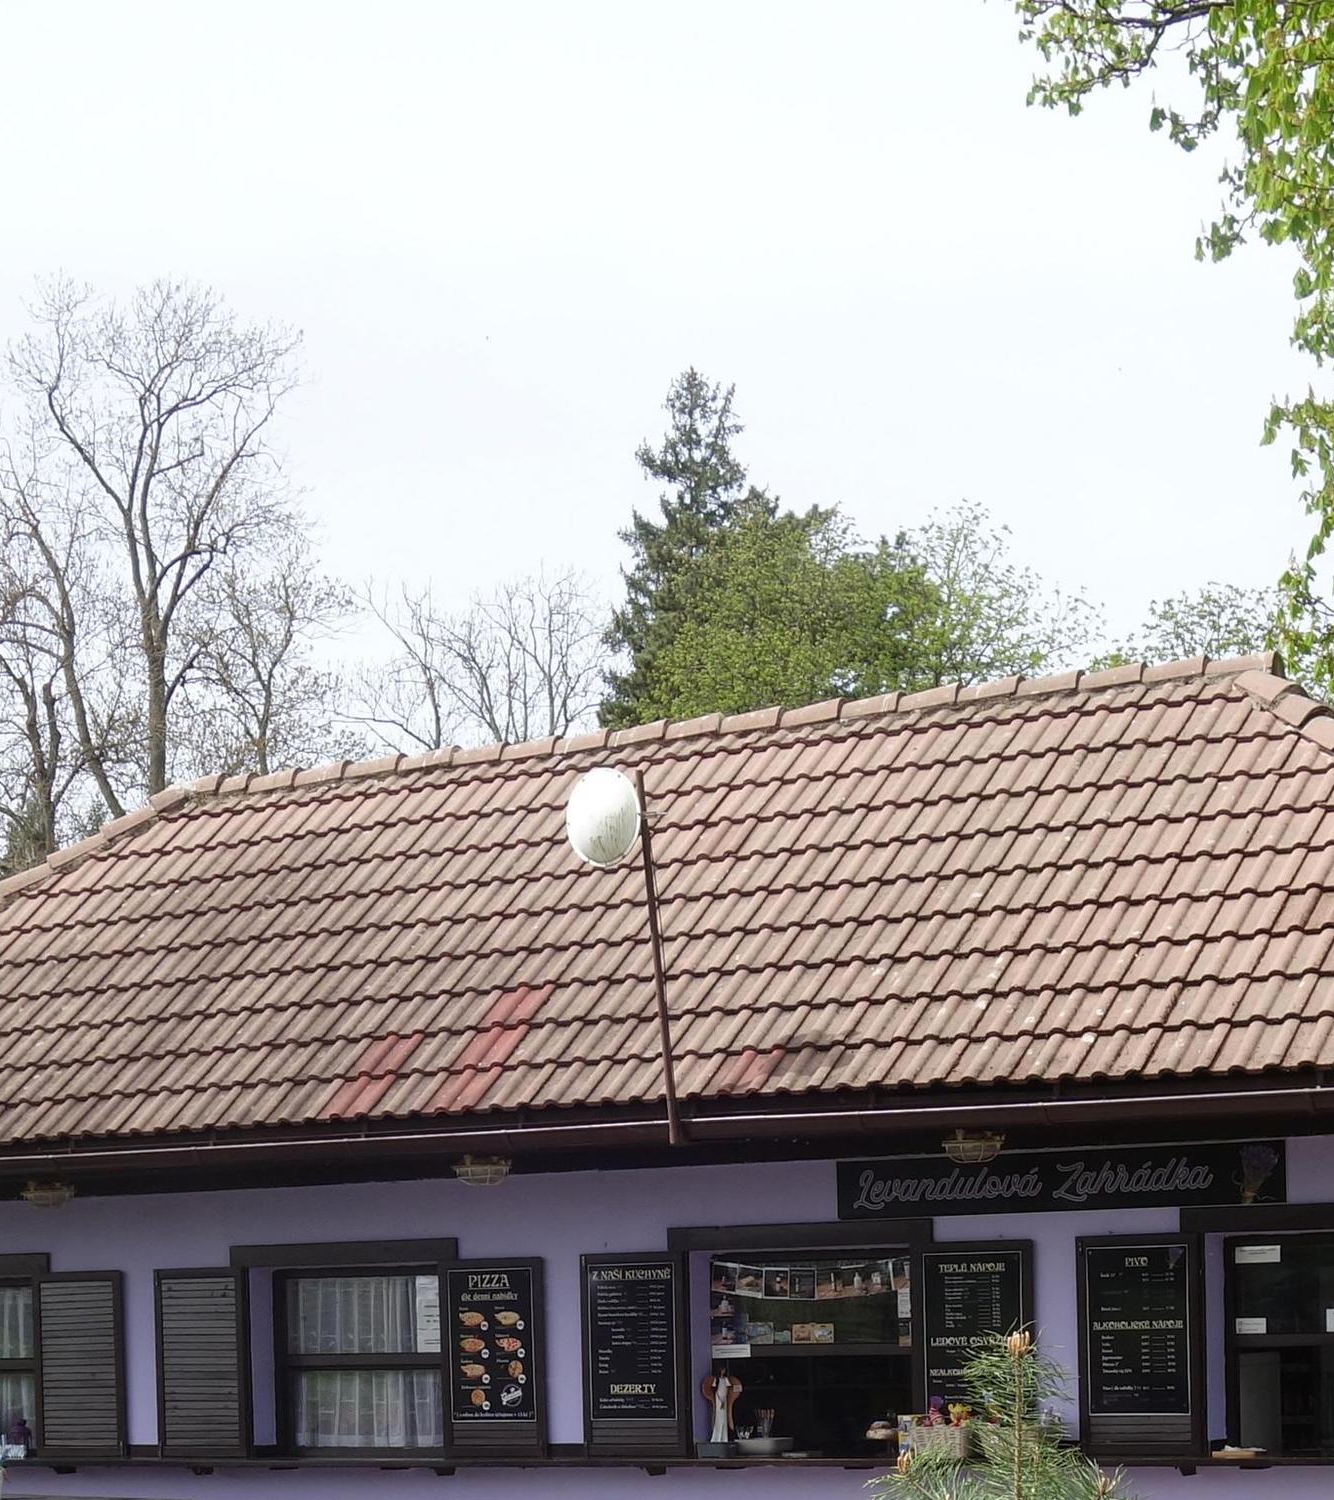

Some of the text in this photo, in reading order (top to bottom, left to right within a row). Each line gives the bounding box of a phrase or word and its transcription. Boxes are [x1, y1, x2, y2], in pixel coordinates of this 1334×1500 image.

[853, 1157, 1216, 1209] Levandulová Zahrádka
[1124, 1256, 1148, 1267] PIVO
[625, 1267, 671, 1280] KUCHYNĚ
[468, 1274, 509, 1288] PIZZA
[610, 1384, 656, 1395] DEZERTY
